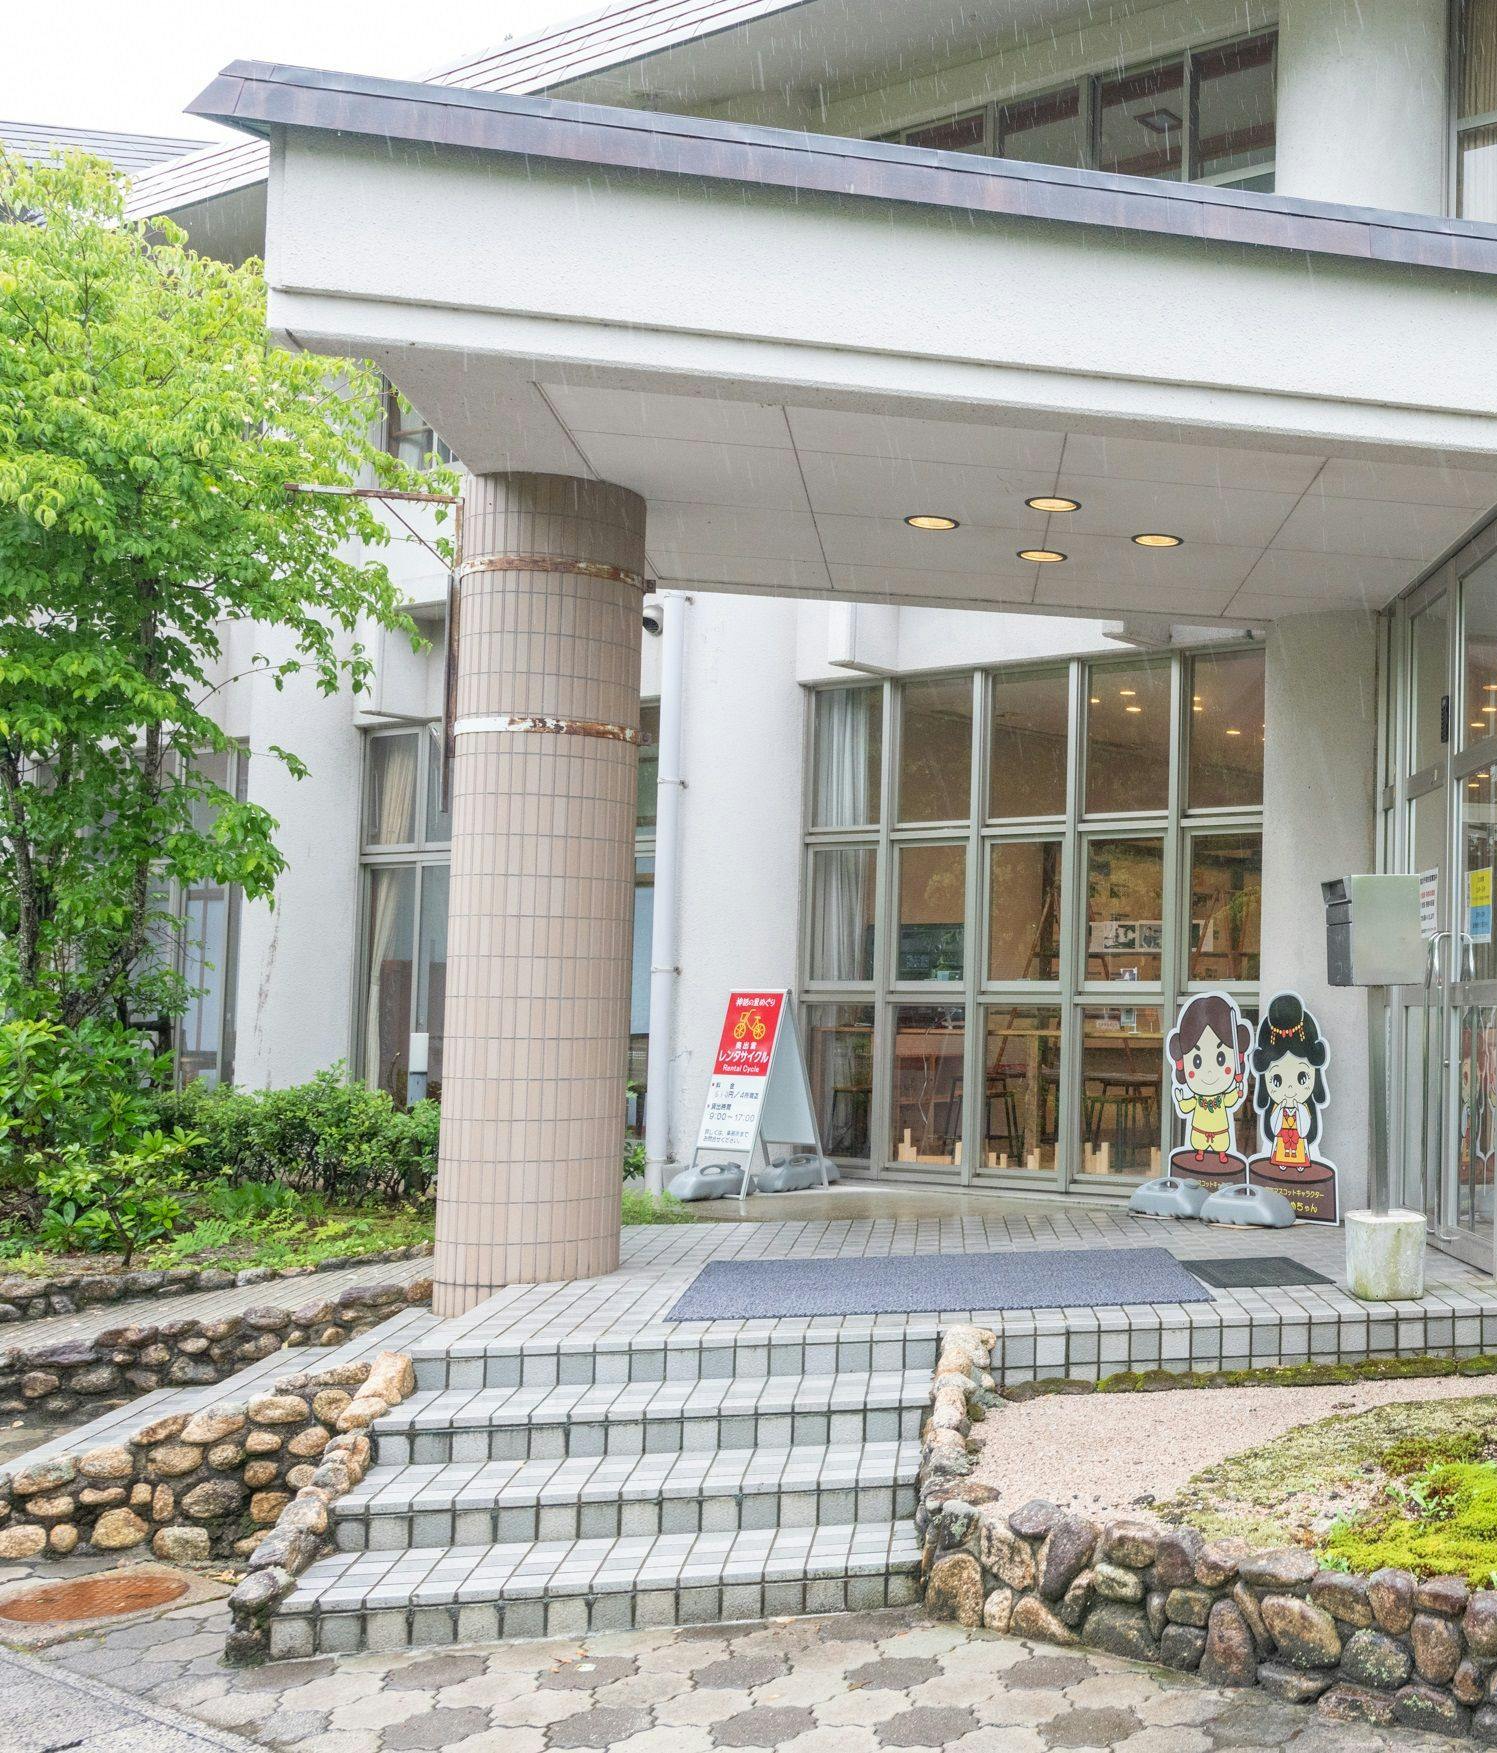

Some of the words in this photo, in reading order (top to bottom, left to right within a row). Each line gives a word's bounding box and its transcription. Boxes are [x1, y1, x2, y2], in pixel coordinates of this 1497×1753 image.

[718, 1049, 770, 1063] レンタサイクル
[723, 1064, 741, 1072] Rental
[743, 1065, 759, 1073] Cycle
[1265, 1186, 1325, 1199] マスコットキャラクター
